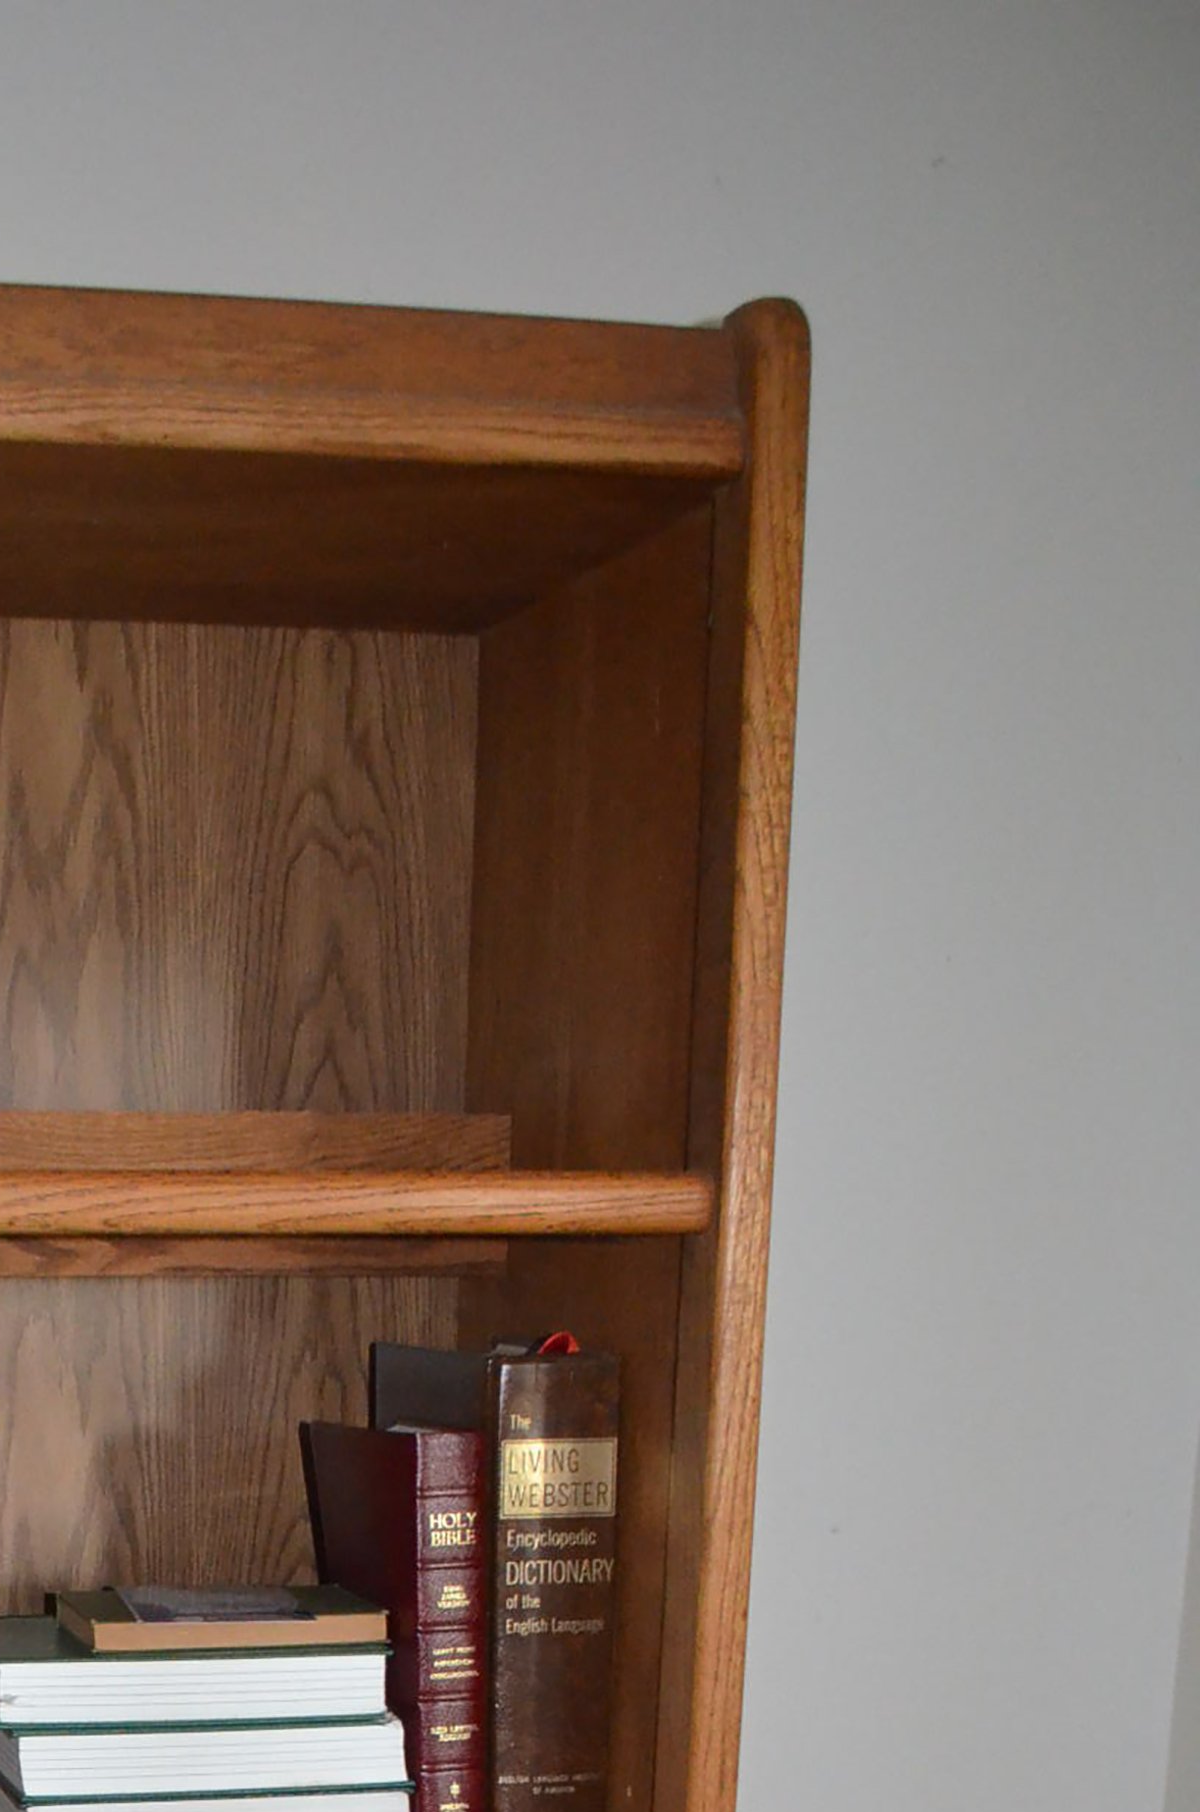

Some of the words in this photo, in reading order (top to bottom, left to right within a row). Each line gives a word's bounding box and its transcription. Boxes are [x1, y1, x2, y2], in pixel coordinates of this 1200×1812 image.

[511, 1414, 531, 1431] The
[508, 1448, 580, 1476] LIVING
[508, 1481, 609, 1509] WEBSTER
[429, 1512, 477, 1530] HOLY
[431, 1529, 477, 1547] BIBLE
[507, 1529, 597, 1550] Encyclopedic
[506, 1558, 614, 1586] DICTIONARY
[506, 1595, 518, 1610] of
[521, 1594, 541, 1609] the
[506, 1618, 548, 1636] English
[551, 1616, 603, 1635] Language
